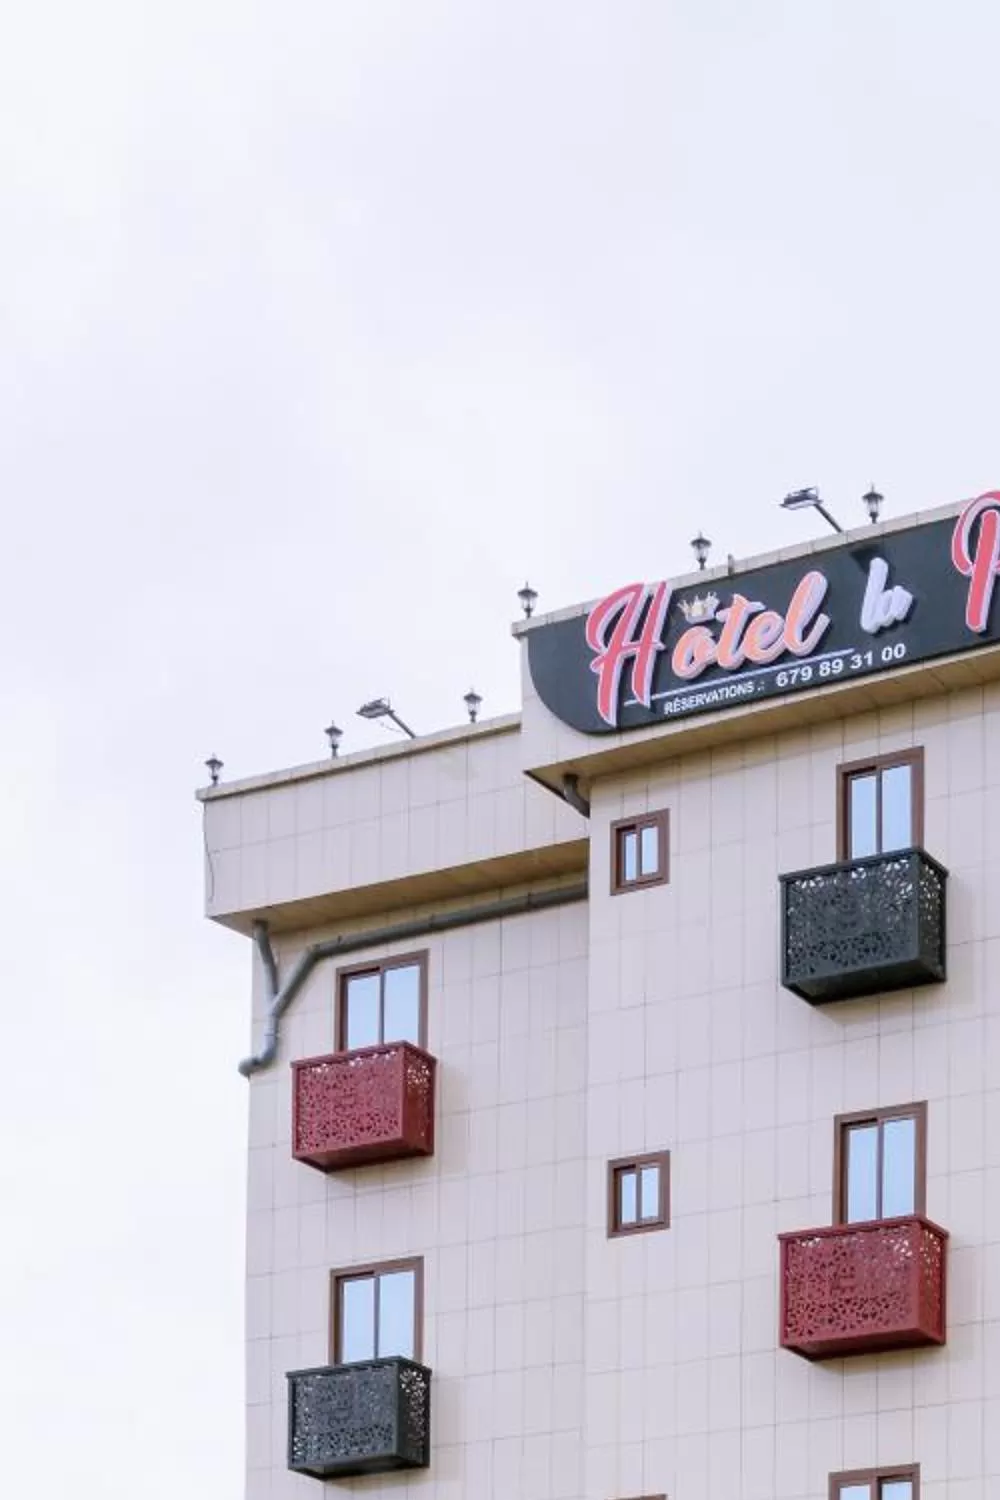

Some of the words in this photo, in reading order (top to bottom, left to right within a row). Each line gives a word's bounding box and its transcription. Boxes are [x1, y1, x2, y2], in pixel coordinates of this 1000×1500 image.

[775, 665, 813, 688] 679
[819, 658, 844, 678] 89
[850, 651, 874, 670] 31
[881, 643, 907, 662] 00
